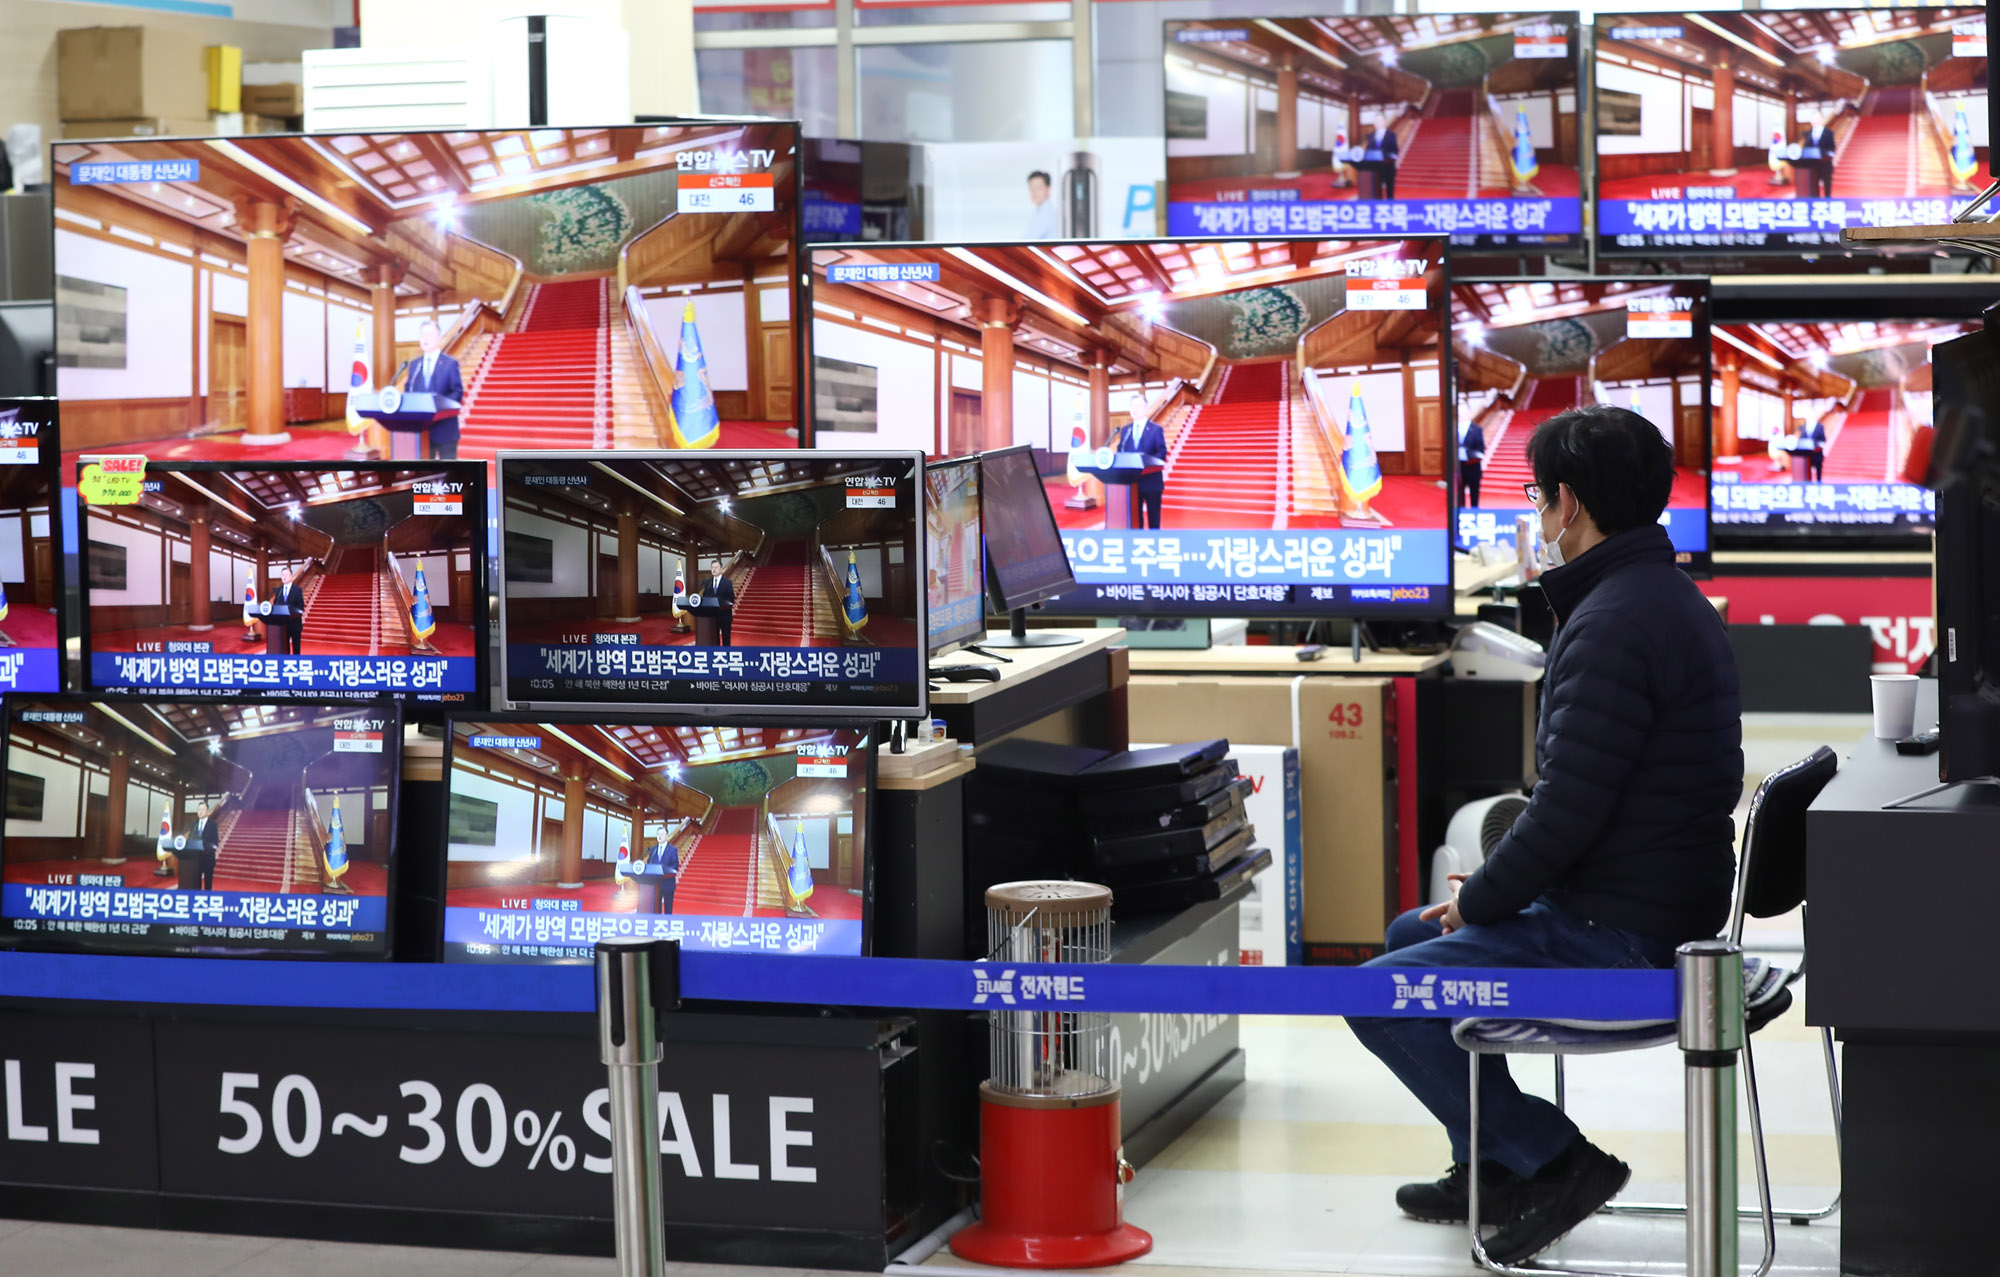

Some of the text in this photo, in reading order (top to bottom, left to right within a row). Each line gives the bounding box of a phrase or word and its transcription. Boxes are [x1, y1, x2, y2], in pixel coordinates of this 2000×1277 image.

[78, 163, 192, 182] 문재인 대통령 신년사
[1651, 187, 1680, 200] LIVE
[689, 193, 755, 207] 대전 46
[1251, 206, 1287, 233] 방역
[833, 265, 932, 281] 문재인 대통령 신년사
[103, 459, 142, 472] SALE!
[525, 476, 587, 486] 문재인 대통령 신년사
[877, 498, 886, 506] 46
[444, 504, 453, 512] 46
[1339, 535, 1402, 578] 성과"
[1105, 585, 1145, 600] 바이든
[1192, 585, 1231, 601] 침공시
[1311, 587, 1334, 600] 제보
[1391, 587, 1429, 601] jebo23
[563, 634, 587, 643] LIVE
[595, 634, 637, 645] 청와대 본관
[136, 642, 162, 652] LIVE
[541, 648, 593, 674] "세계가
[596, 650, 627, 675] 방역
[630, 651, 710, 676] 모범국으로
[842, 652, 880, 678] 성과"
[115, 656, 167, 683] "세계가
[169, 657, 200, 684] 방역
[202, 659, 280, 685] 모범국으로
[410, 660, 448, 688] 성과"
[530, 679, 554, 688] 10:05
[627, 681, 639, 690] 1년
[641, 681, 649, 691] 더
[696, 681, 720, 691] 바이든
[1328, 703, 1363, 727] 43
[474, 738, 537, 748] 문재인 대통령 신년사
[48, 874, 73, 884] LIVE
[26, 887, 77, 916] "세계가
[79, 891, 110, 918] 방역
[112, 893, 190, 920] 모범국으로
[321, 898, 359, 927] 성과"
[502, 899, 527, 909] LIVE
[14, 919, 37, 930] 10:05
[121, 924, 130, 934] 더
[175, 926, 199, 937] 바이든
[301, 931, 315, 940] 제보
[350, 932, 374, 942] jebo23
[479, 912, 531, 940] "세계가
[534, 915, 566, 942] 방역
[784, 922, 824, 951] 성과"
[467, 944, 491, 955] 10:05
[580, 949, 588, 959] 더
[1020, 976, 1085, 1000] 전자랜드
[1441, 980, 1509, 1006] 전자랜드
